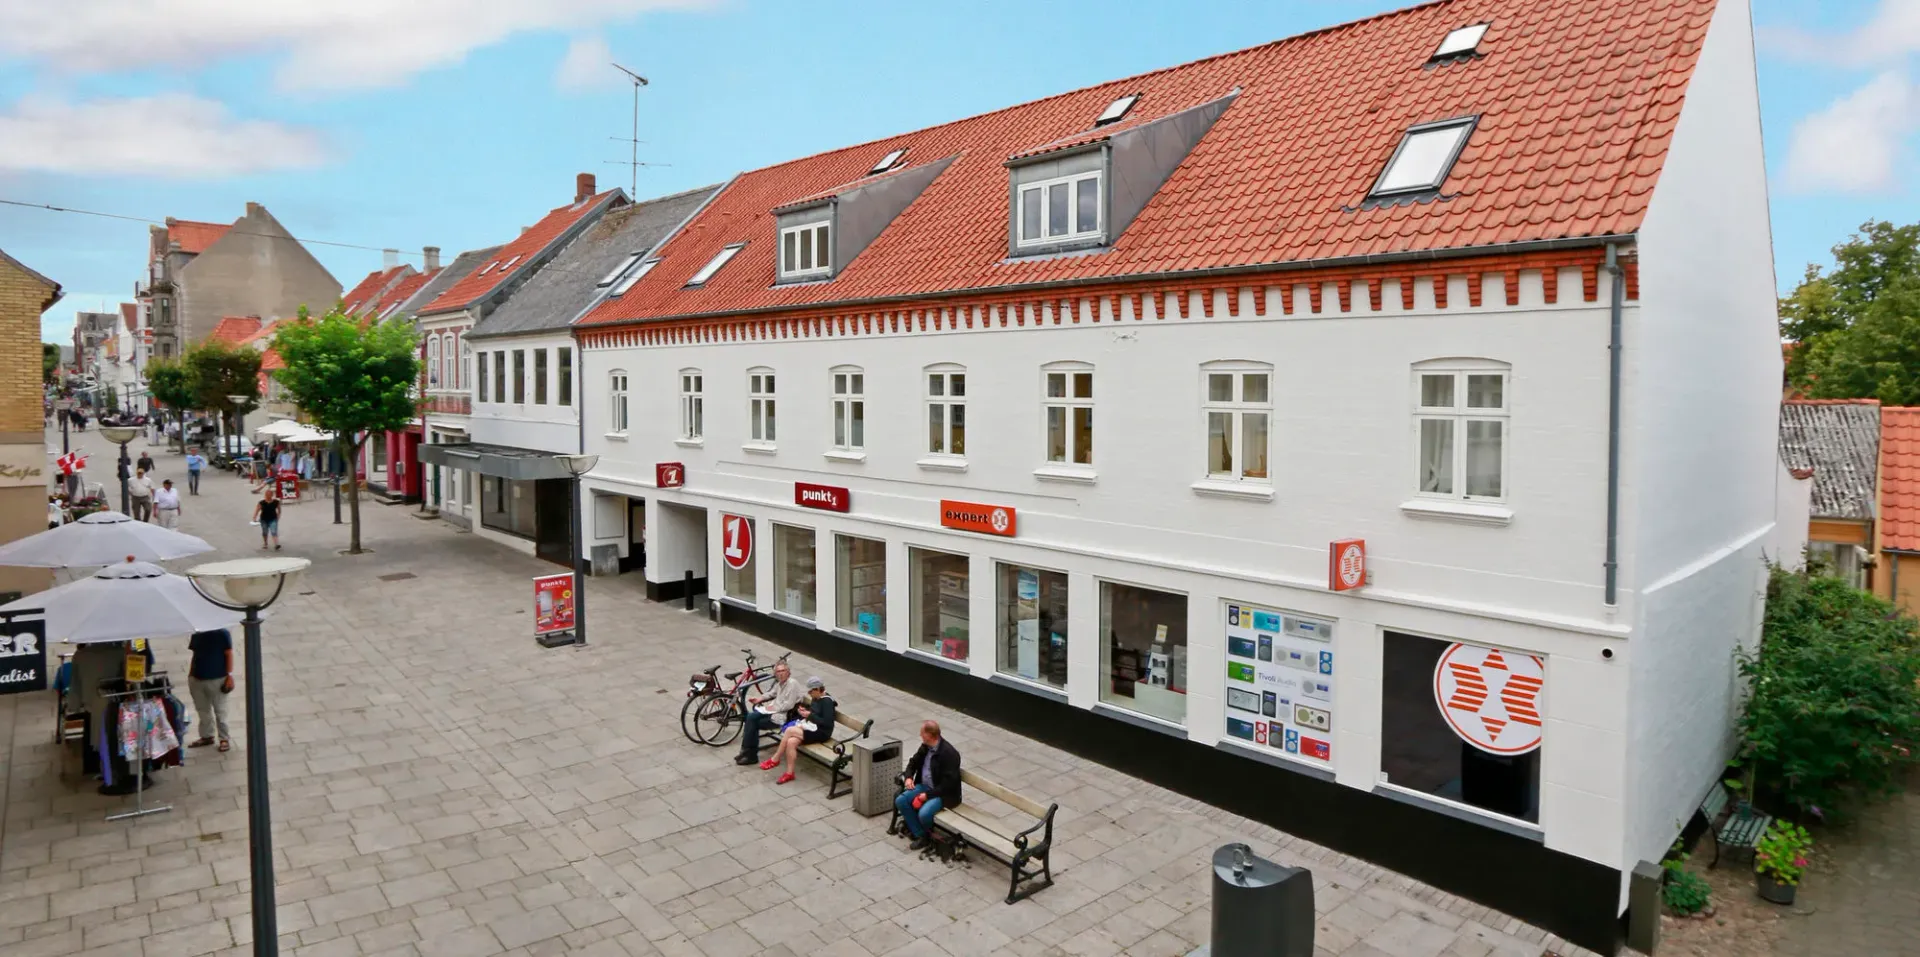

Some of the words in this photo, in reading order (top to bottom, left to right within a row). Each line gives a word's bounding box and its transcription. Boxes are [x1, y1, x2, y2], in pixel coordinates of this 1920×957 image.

[667, 469, 678, 485] 1
[945, 510, 988, 524] expert
[725, 518, 743, 559] 1
[1258, 672, 1276, 682] Tivoli
